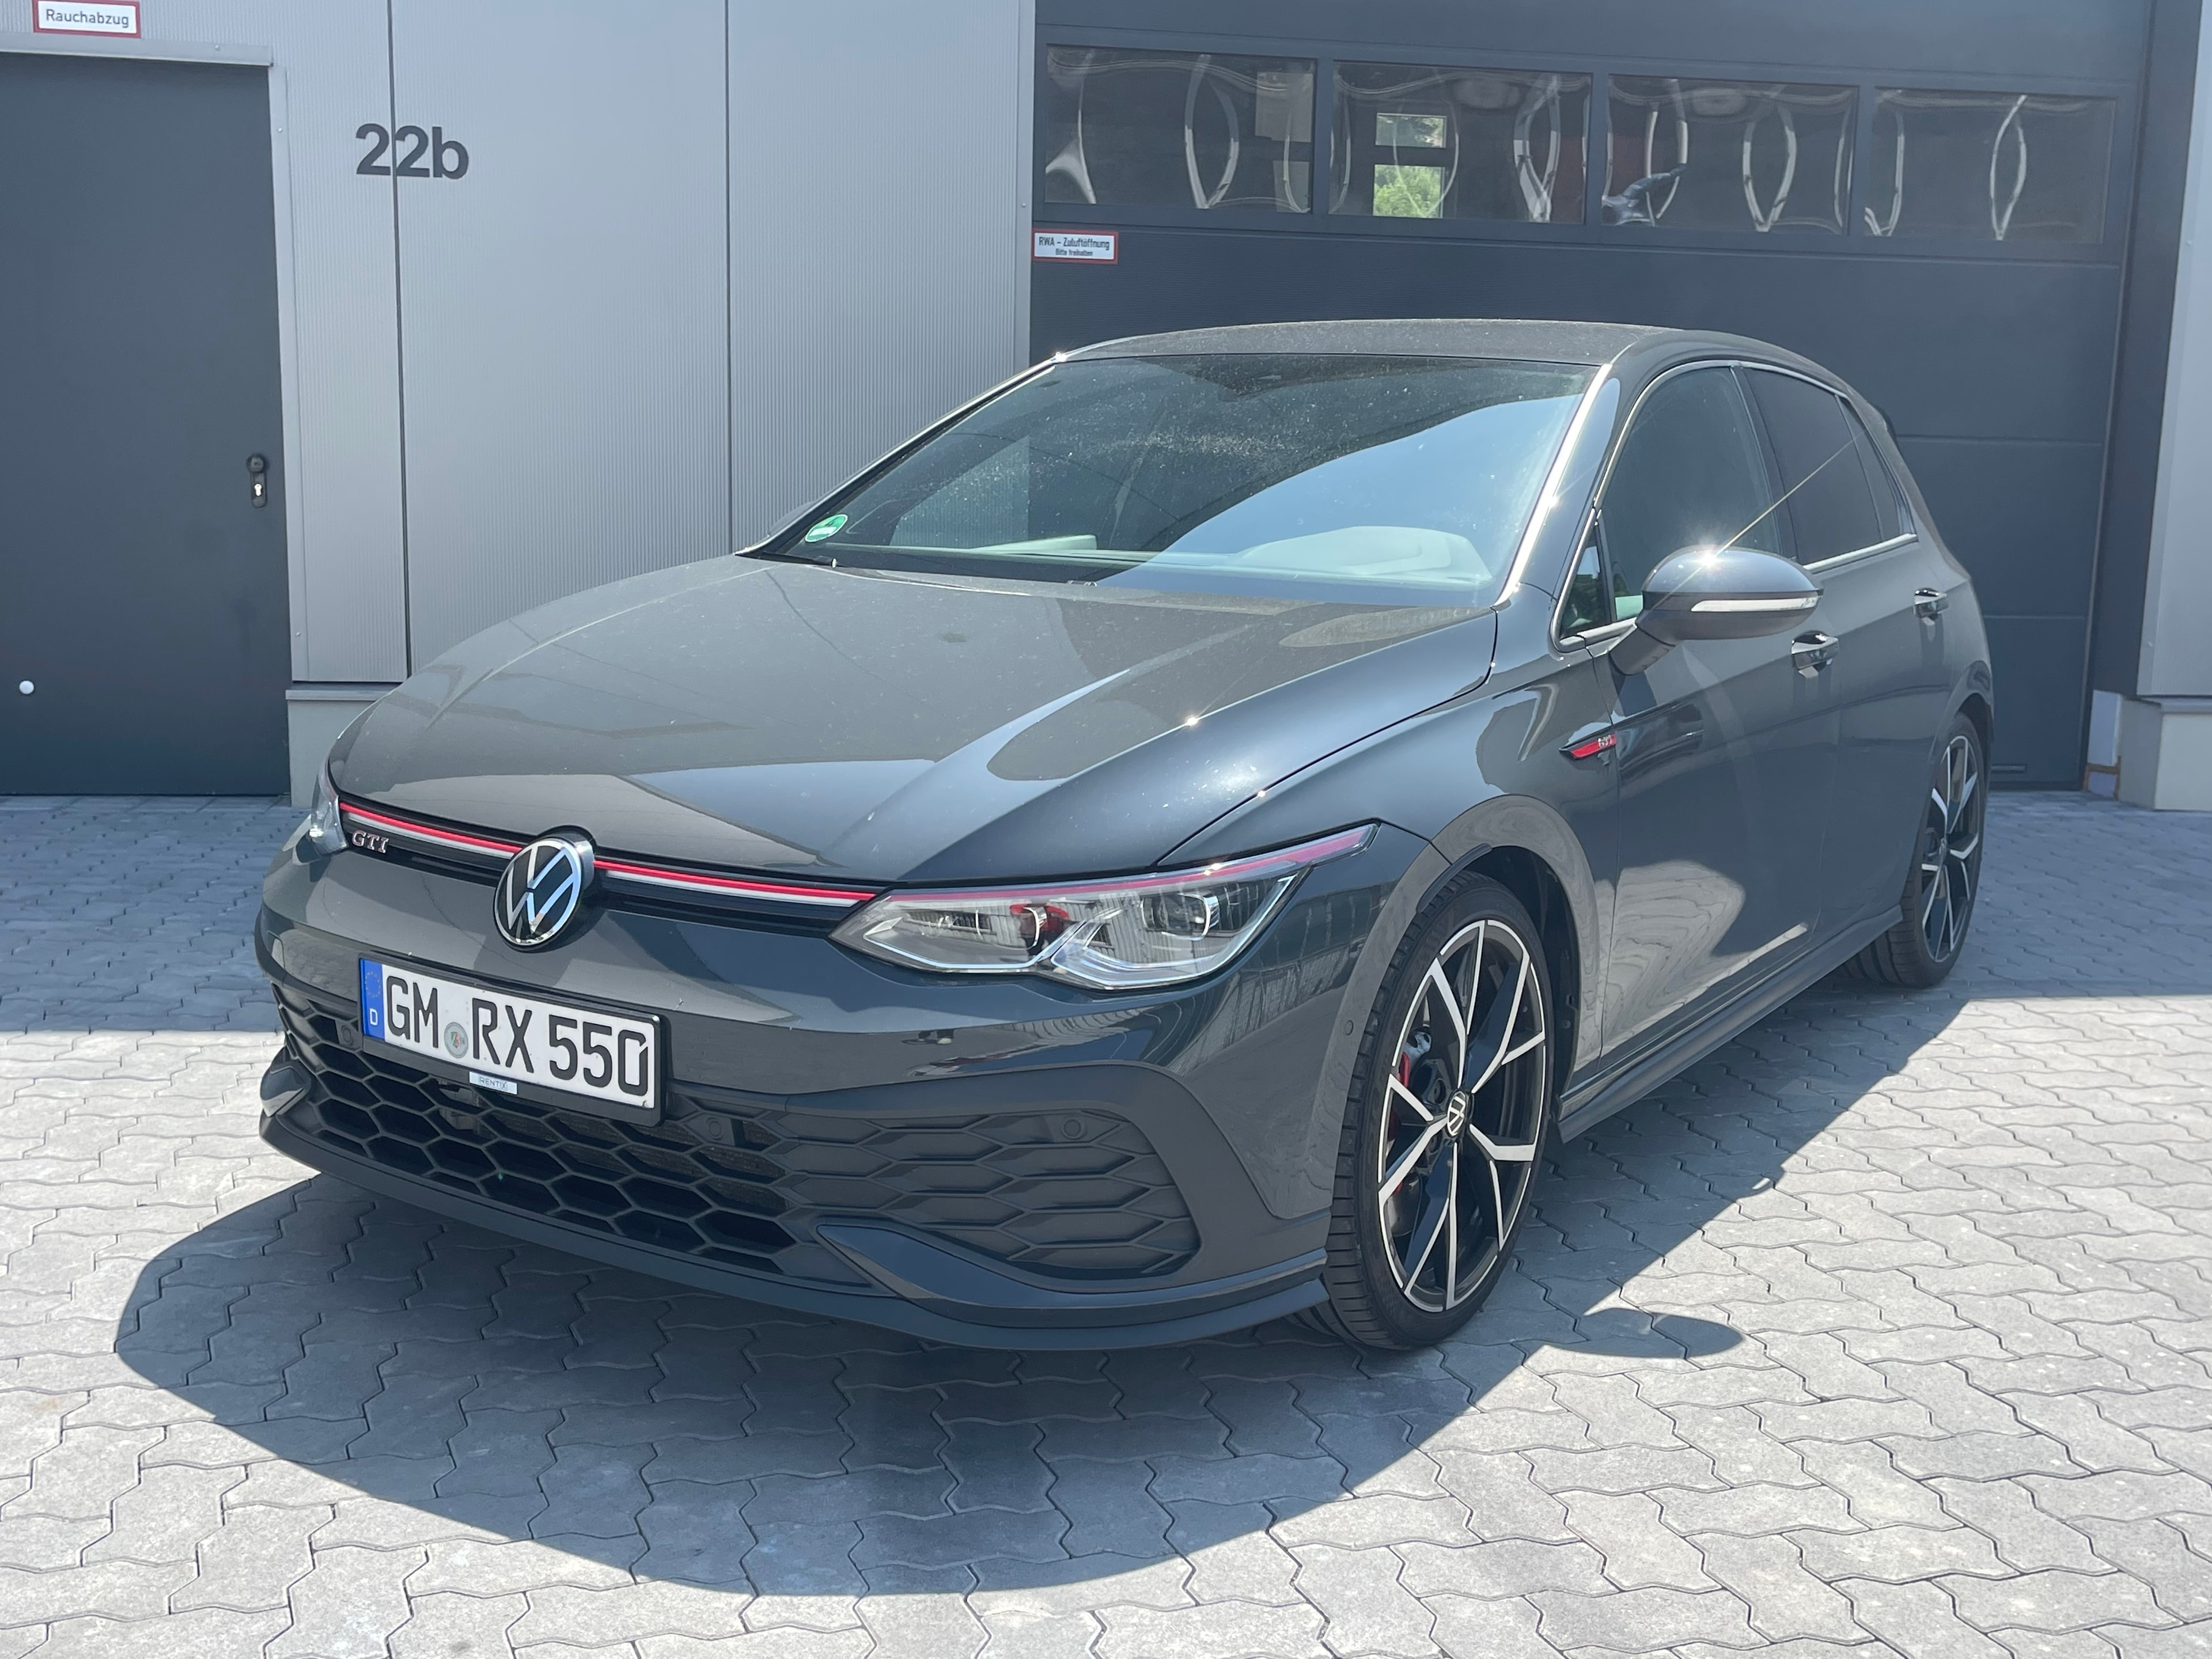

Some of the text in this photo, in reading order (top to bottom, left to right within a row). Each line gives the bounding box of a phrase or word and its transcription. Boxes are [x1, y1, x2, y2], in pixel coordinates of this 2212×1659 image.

[46, 9, 130, 28] Rauchabzug
[355, 123, 469, 180] 22b
[1039, 237, 1055, 247] RWA
[1063, 237, 1110, 251] Zuluftöffnung
[351, 830, 389, 853] GTI
[369, 1008, 378, 1026] D
[387, 975, 648, 1096] GM RX 550
[479, 1077, 507, 1090] RENTIX
